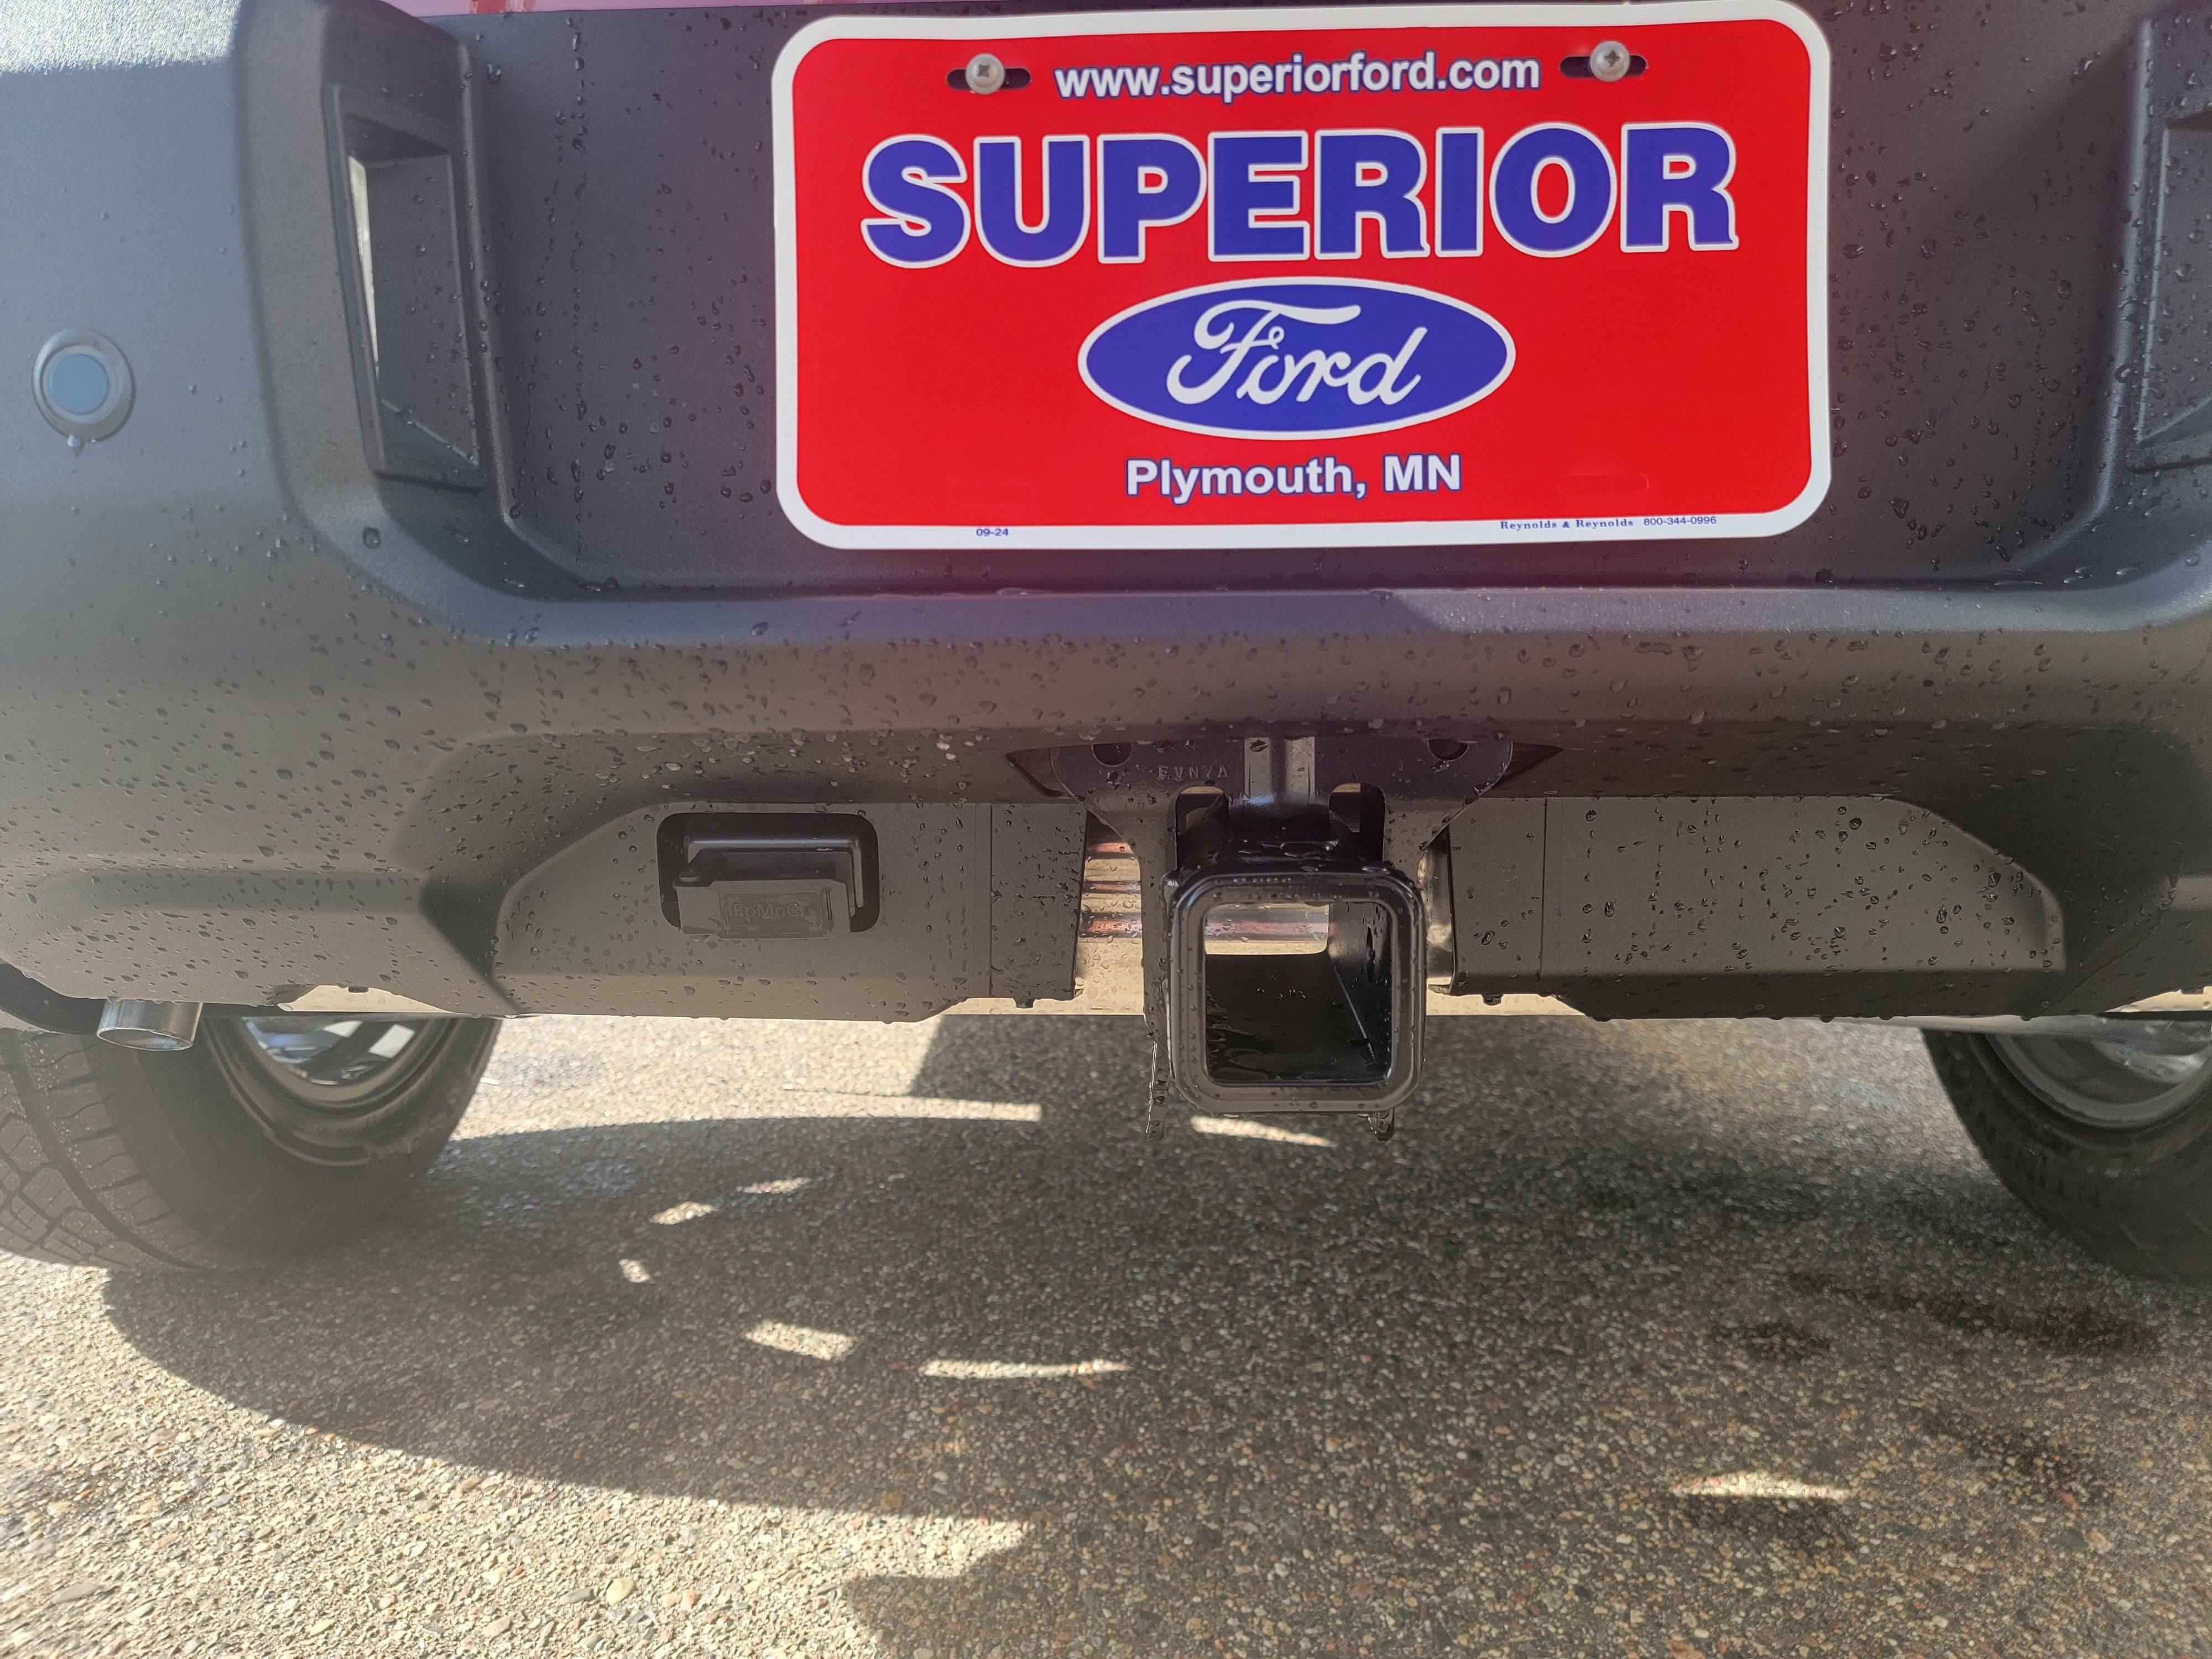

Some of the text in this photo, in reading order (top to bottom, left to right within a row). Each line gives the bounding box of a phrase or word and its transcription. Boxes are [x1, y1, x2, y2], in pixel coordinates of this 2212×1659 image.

[1054, 50, 1541, 104] www.superiorford.com
[860, 122, 1739, 269] SUPERIOR
[1166, 300, 1428, 405] Ford
[1126, 453, 1462, 505] Plymouth, MN
[976, 528, 1009, 536] 09-24
[1500, 521, 1557, 531] Reynolds
[1575, 519, 1634, 530] Reynolds
[1644, 516, 1717, 526] 800-344-0996
[733, 902, 813, 917] FoMoCo
